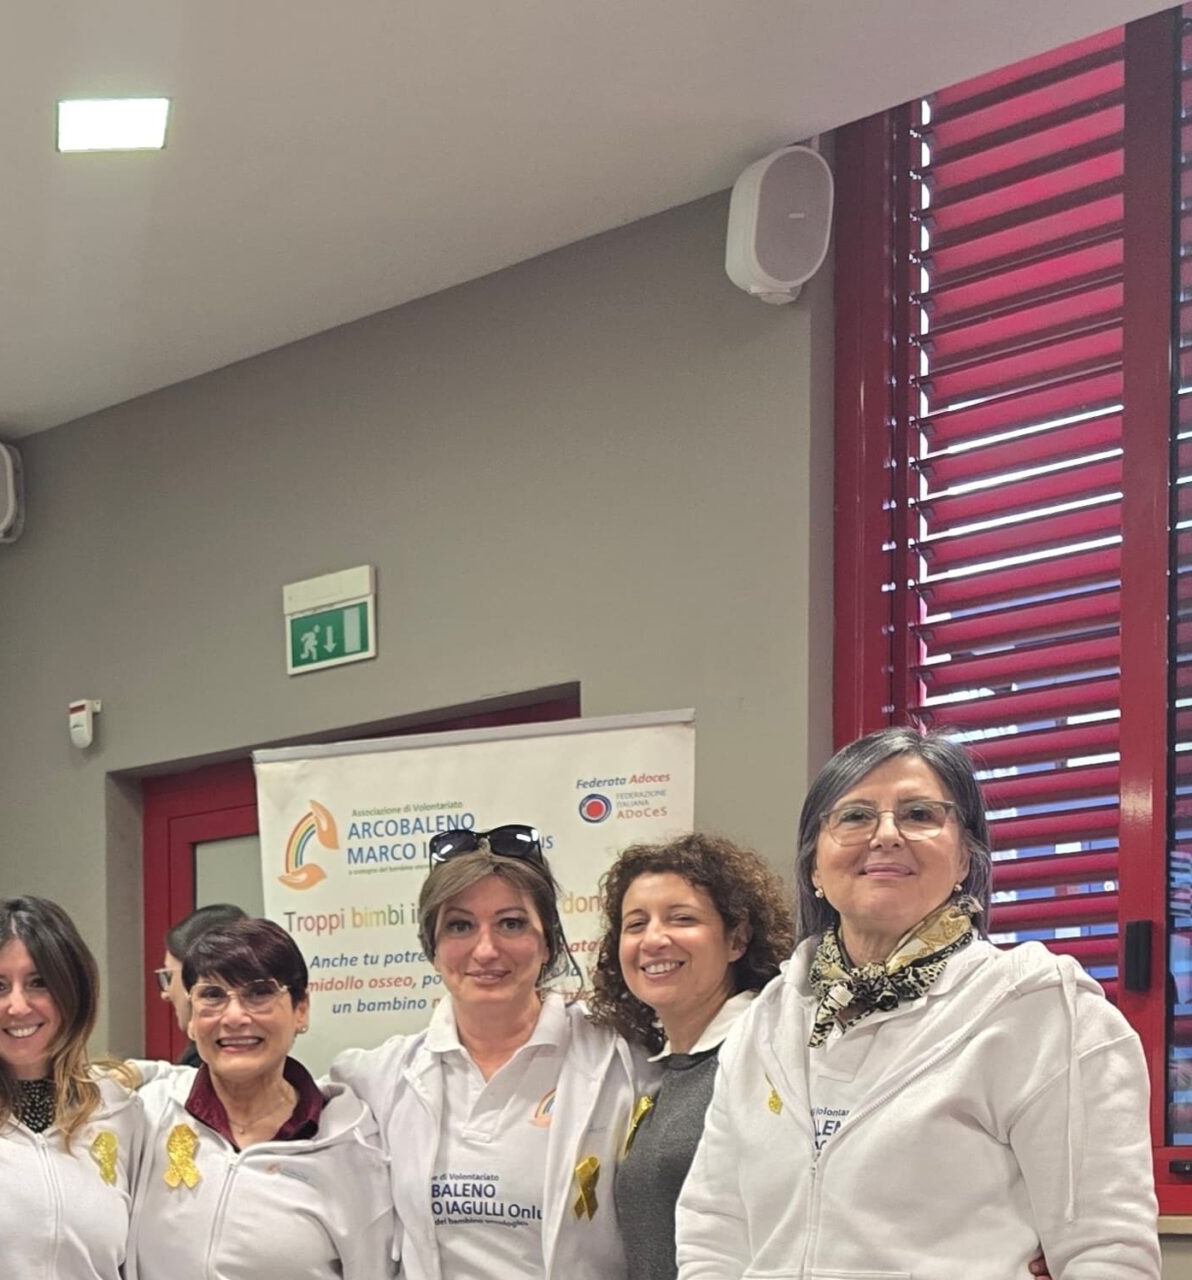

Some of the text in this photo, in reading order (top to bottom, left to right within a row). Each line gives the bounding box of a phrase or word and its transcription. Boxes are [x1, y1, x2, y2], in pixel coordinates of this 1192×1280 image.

[576, 773, 671, 789] Federata Adoces
[352, 801, 463, 817] Associazione di Volontariato
[617, 806, 668, 819] ADoCeS
[348, 812, 475, 840] ARCOBALENO
[348, 842, 417, 864] MARCO
[284, 908, 345, 936] Troppi
[352, 903, 404, 929] bimbi
[310, 953, 358, 968] Anche
[363, 952, 379, 965] tu
[308, 975, 364, 992] midollo
[368, 976, 416, 989] osseo,
[332, 1002, 351, 1014] un
[357, 997, 427, 1013] bambino
[449, 1173, 499, 1181] Volontariato
[432, 1183, 496, 1198] BALENO
[446, 1201, 504, 1216] IAGULLI
